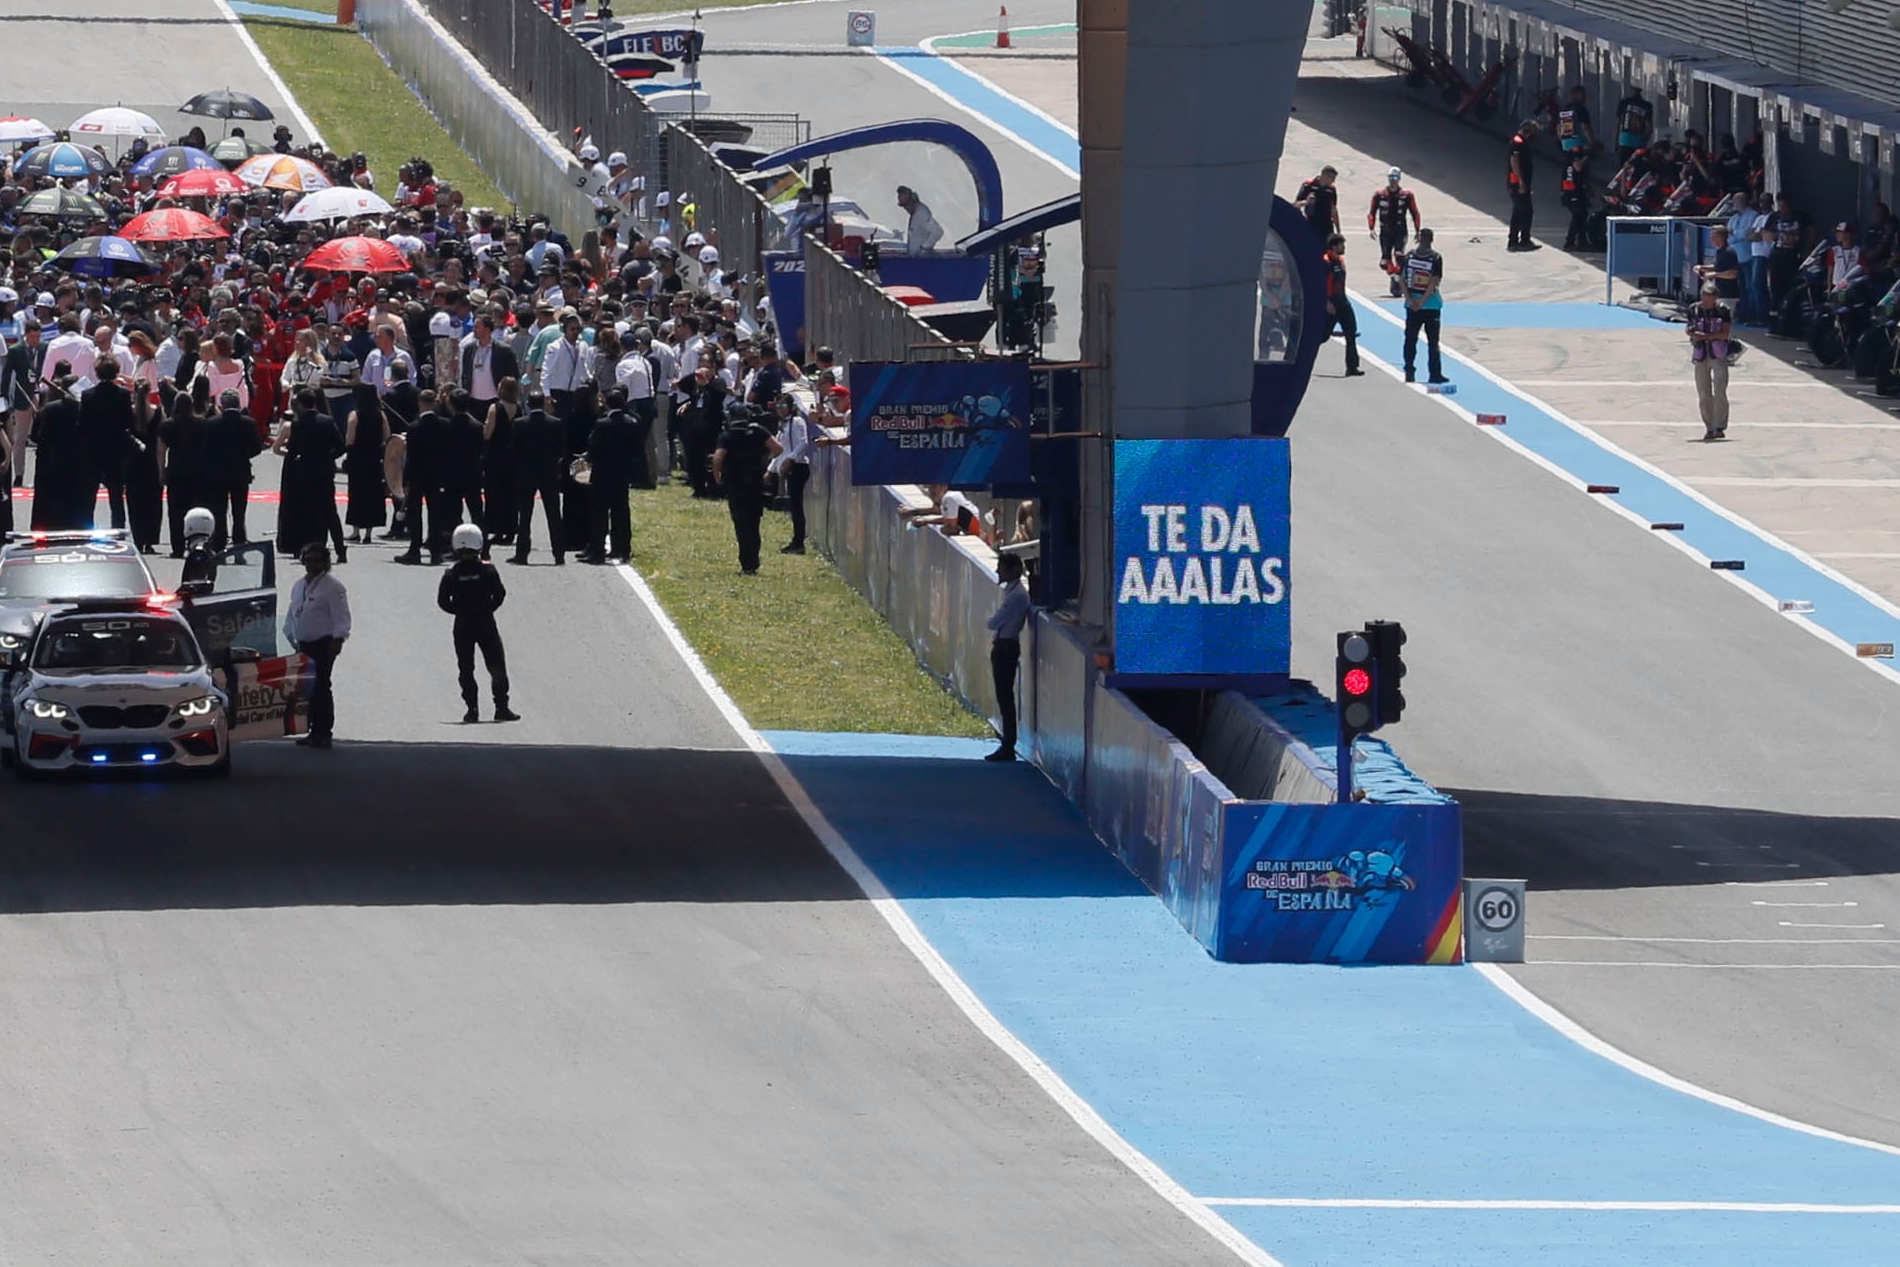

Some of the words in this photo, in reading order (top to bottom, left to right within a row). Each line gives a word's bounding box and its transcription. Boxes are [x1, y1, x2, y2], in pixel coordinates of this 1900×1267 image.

[773, 260, 806, 272] 202
[899, 431, 965, 449] ESPAÑA
[1141, 505, 1187, 553] TE
[1201, 505, 1261, 553] DA
[1118, 556, 1286, 605] AAALAS
[1256, 860, 1288, 872] GRAN
[1291, 860, 1333, 872] PREMIO
[1247, 873, 1278, 890] Red
[1278, 873, 1308, 889] Bull
[1266, 890, 1279, 899] DE
[1278, 889, 1352, 910] ESPAÑA
[1482, 900, 1513, 920] 60
